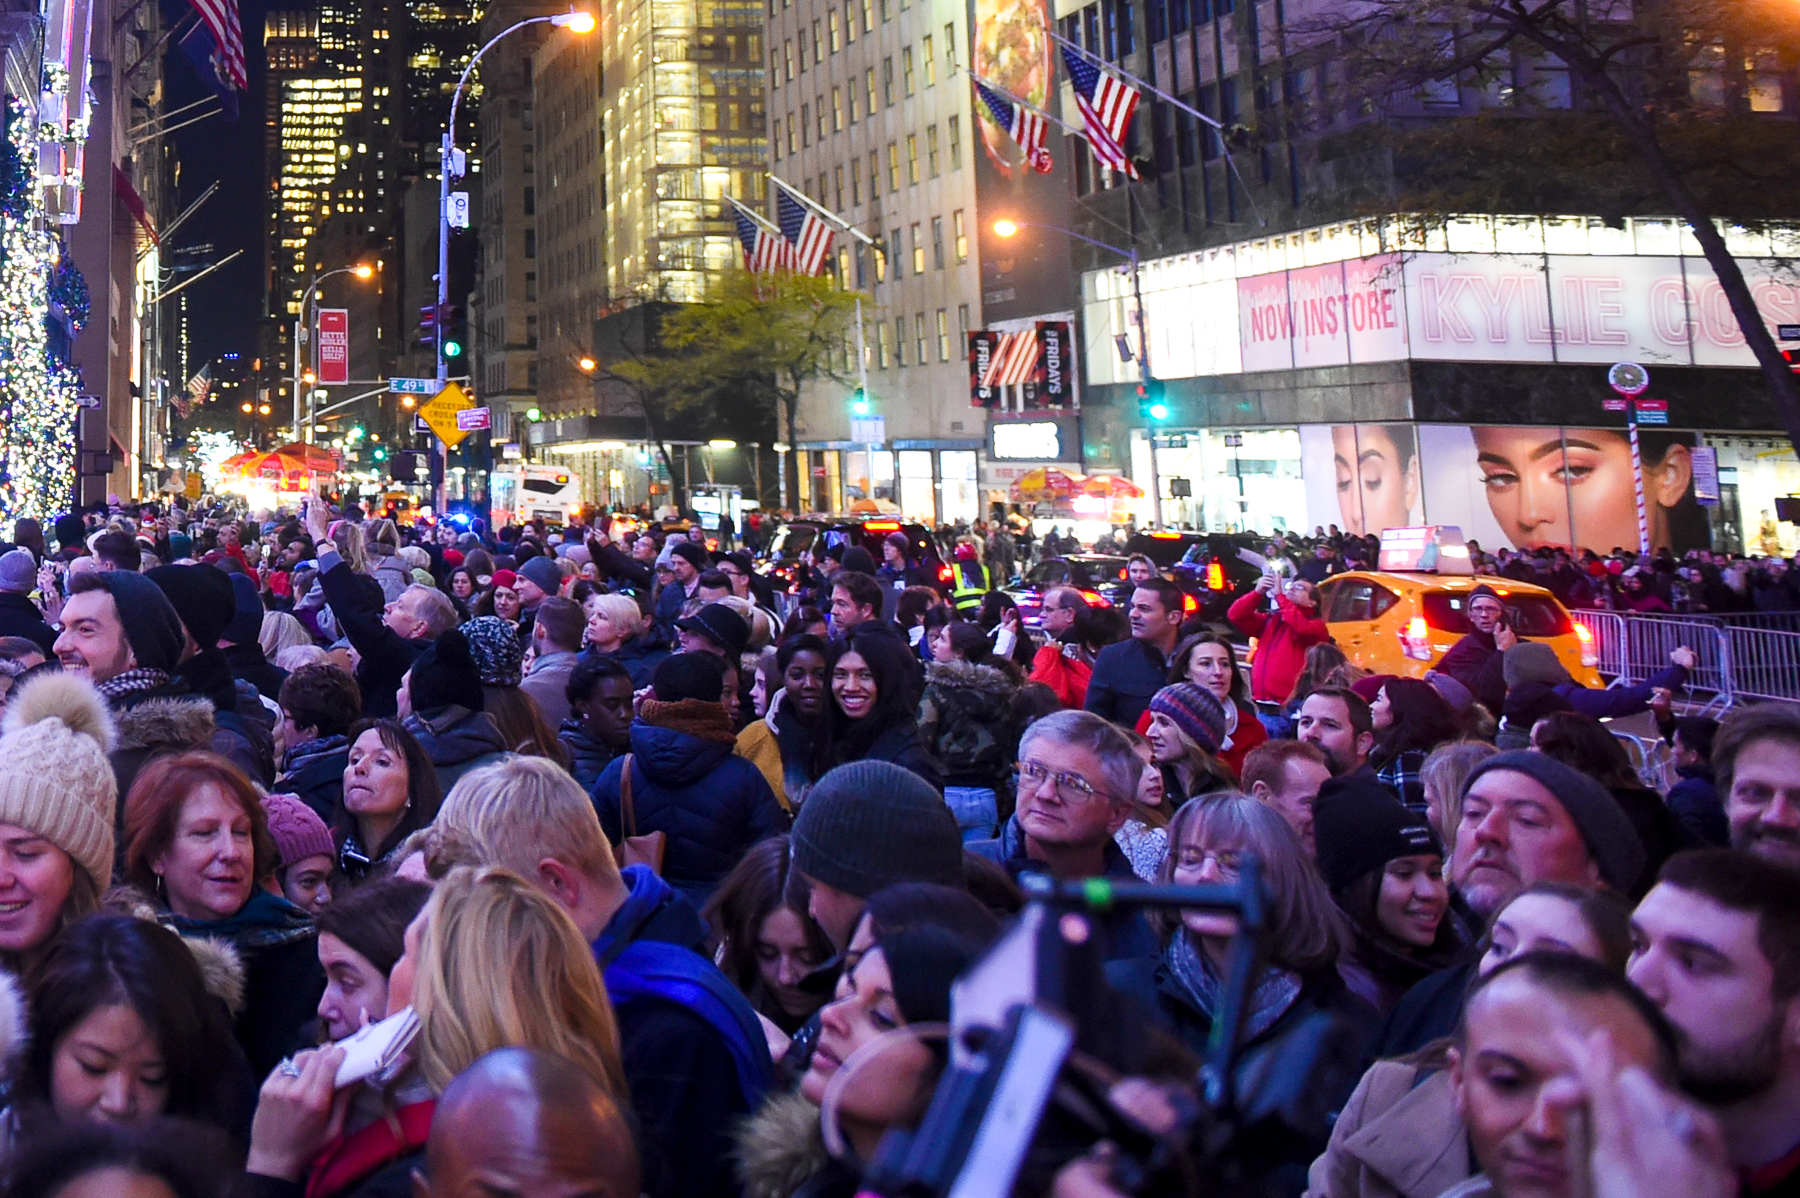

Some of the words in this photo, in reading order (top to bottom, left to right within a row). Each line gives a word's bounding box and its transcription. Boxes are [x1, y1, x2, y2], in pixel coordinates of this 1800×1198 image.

[1251, 299, 1298, 343] NOW
[1419, 273, 1630, 346] KYLIE
[391, 380, 398, 390] E
[401, 380, 417, 391] 49
[1046, 338, 1062, 394] FRIDAYS
